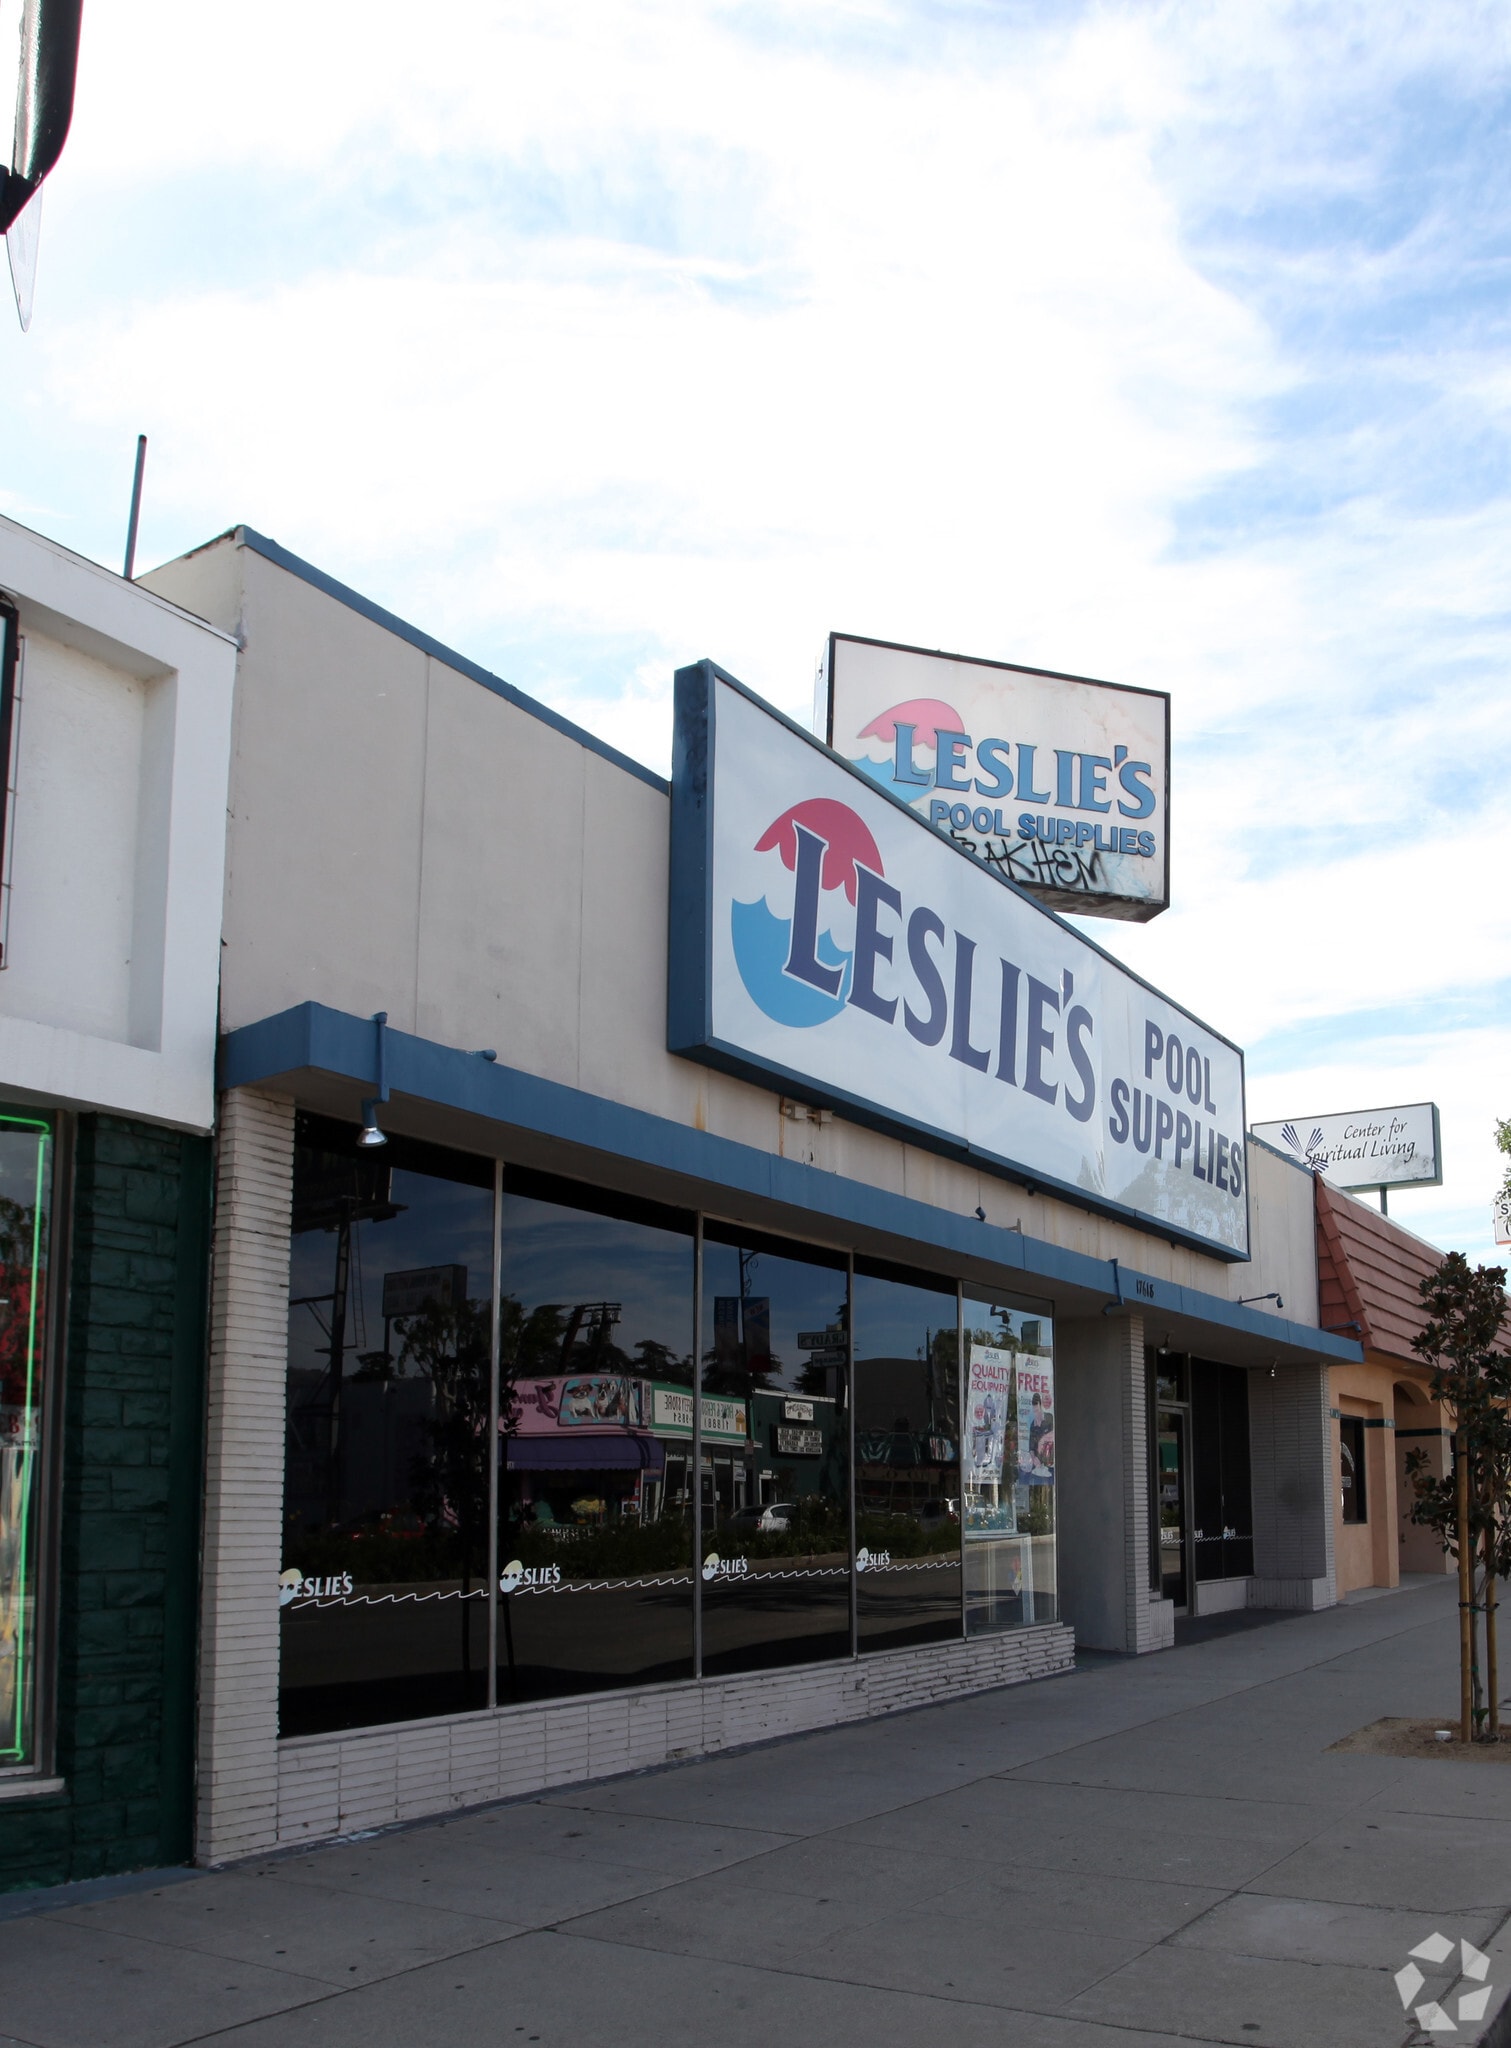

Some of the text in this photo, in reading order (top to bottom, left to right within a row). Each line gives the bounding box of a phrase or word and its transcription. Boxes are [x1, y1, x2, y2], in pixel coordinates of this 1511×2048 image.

[893, 722, 1157, 819] LESLIE'S
[930, 799, 1156, 859] POOL SUPPLIES
[783, 821, 1096, 1123] LESLIE'S
[1143, 1018, 1217, 1117] POOL
[1108, 1078, 1243, 1198] SUPPLIES
[1344, 1117, 1408, 1142] Center for
[1303, 1137, 1416, 1170] Spiritual Living
[1136, 1278, 1155, 1298] 17618
[972, 1363, 1010, 1381] QUALITY
[1017, 1371, 1050, 1394] FREE
